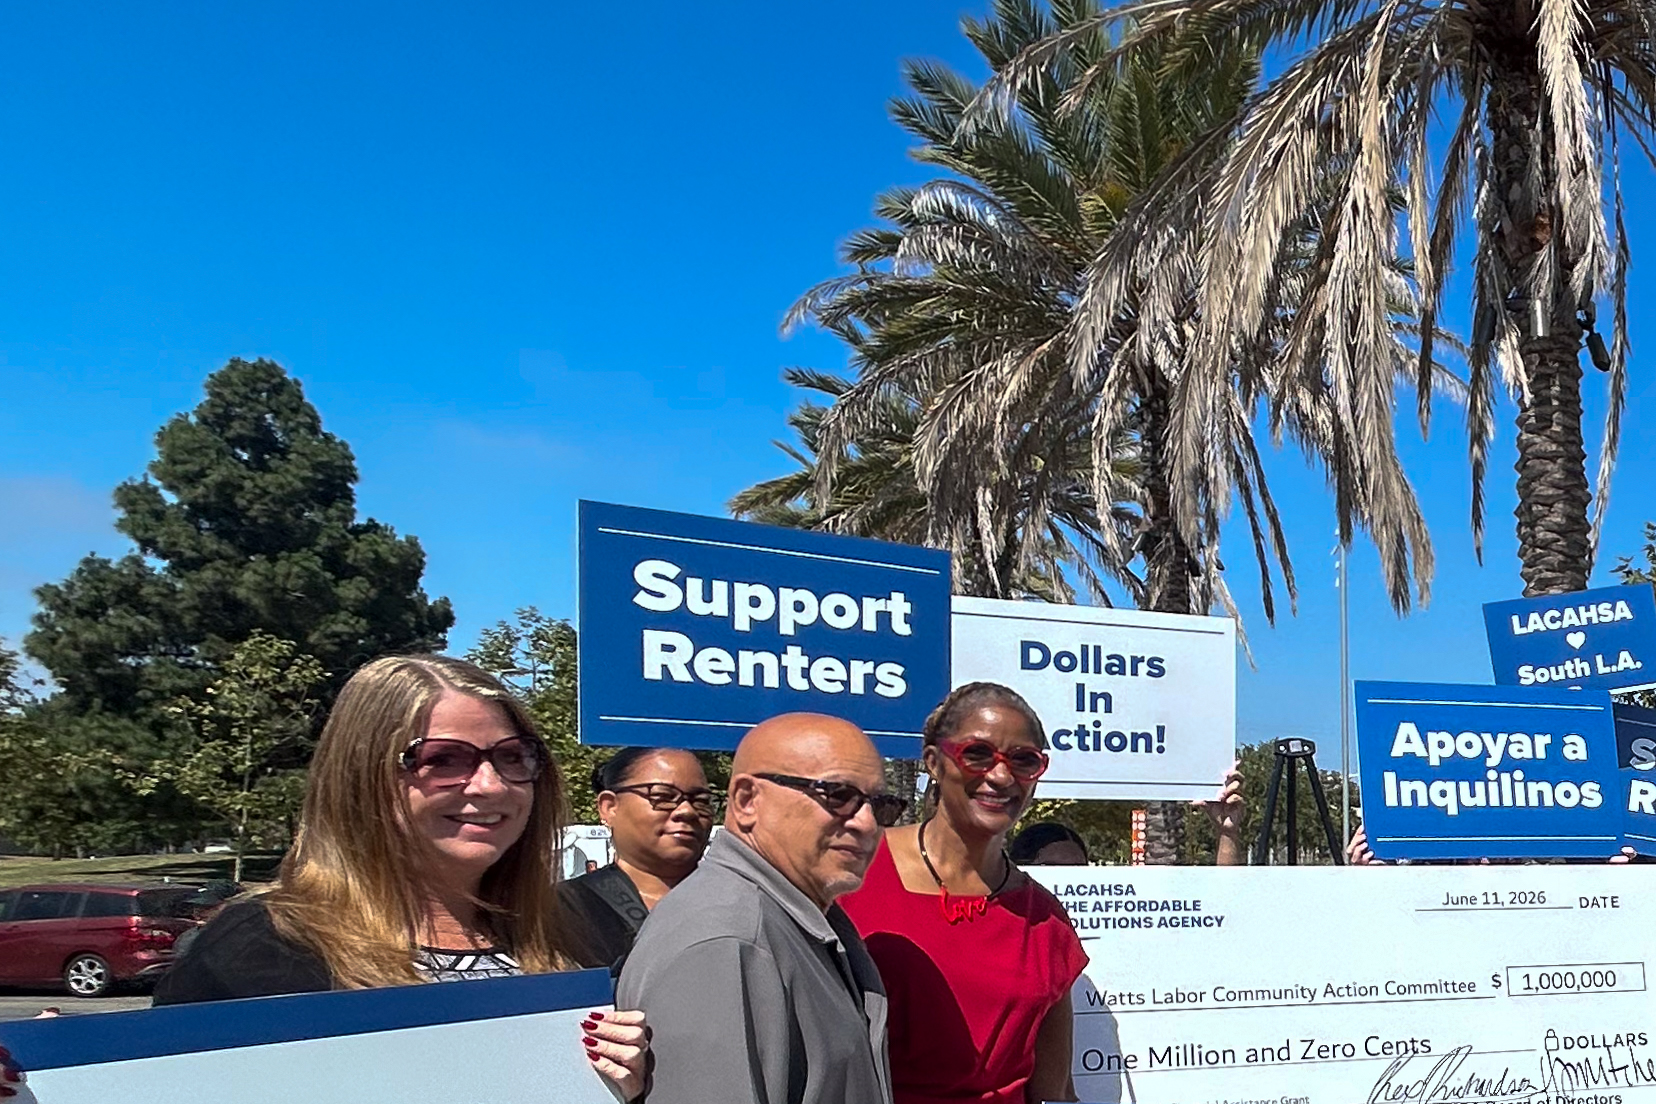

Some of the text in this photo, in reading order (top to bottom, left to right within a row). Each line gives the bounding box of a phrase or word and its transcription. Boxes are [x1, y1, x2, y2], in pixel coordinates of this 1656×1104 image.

[633, 559, 912, 636] Support
[1511, 600, 1633, 635] LACAHSA
[642, 629, 908, 699] Renters
[1020, 640, 1166, 678] Dollars
[1518, 650, 1642, 686] South L.A.
[1076, 682, 1113, 713] In
[1043, 721, 1166, 755] ction!
[1391, 722, 1588, 766] Apoyar a
[1384, 770, 1602, 816] Inquilinos
[1053, 884, 1136, 896] LACAHSA
[1442, 891, 1547, 907] June 11, 2026
[1579, 896, 1620, 909] DATE
[1069, 915, 1225, 929] OLUTIONS AGENCY
[1092, 900, 1202, 913] AFFORDABLE
[1085, 979, 1477, 1007] Watts Labor Community Action Committee
[1491, 970, 1617, 993] $ 1,000,000
[1082, 1035, 1432, 1072] One Million and Zero Cents
[1564, 1033, 1648, 1050] DOLLARS
